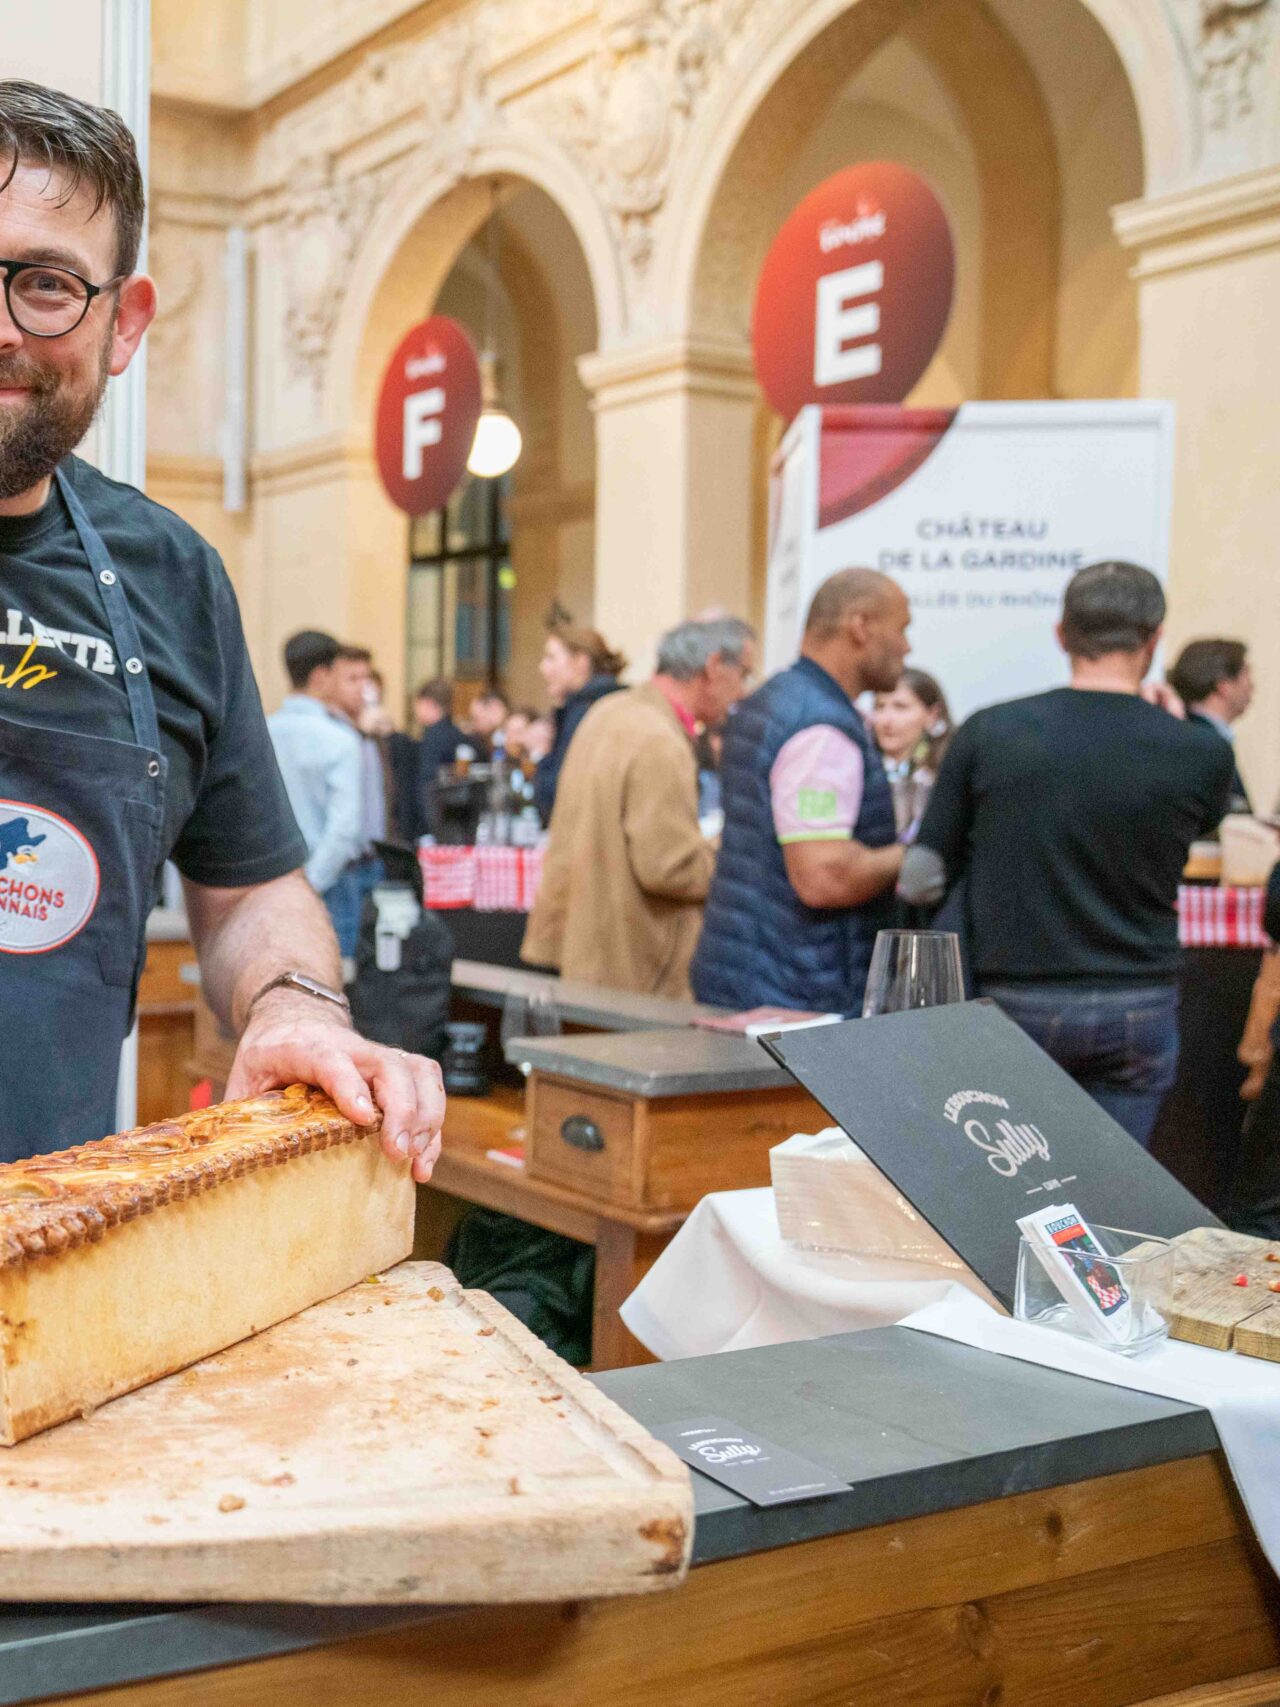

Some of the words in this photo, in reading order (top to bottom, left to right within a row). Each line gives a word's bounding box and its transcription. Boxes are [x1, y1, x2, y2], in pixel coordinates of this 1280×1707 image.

[814, 260, 884, 387] E
[403, 387, 446, 480] F
[916, 514, 1049, 540] CHÂTEAU
[878, 550, 913, 571] DE
[920, 550, 953, 571] LA
[961, 550, 1084, 571] GARDINE
[999, 588, 1060, 609] RHÔN
[964, 1119, 1051, 1177] Sully
[698, 1443, 761, 1464] Sully
